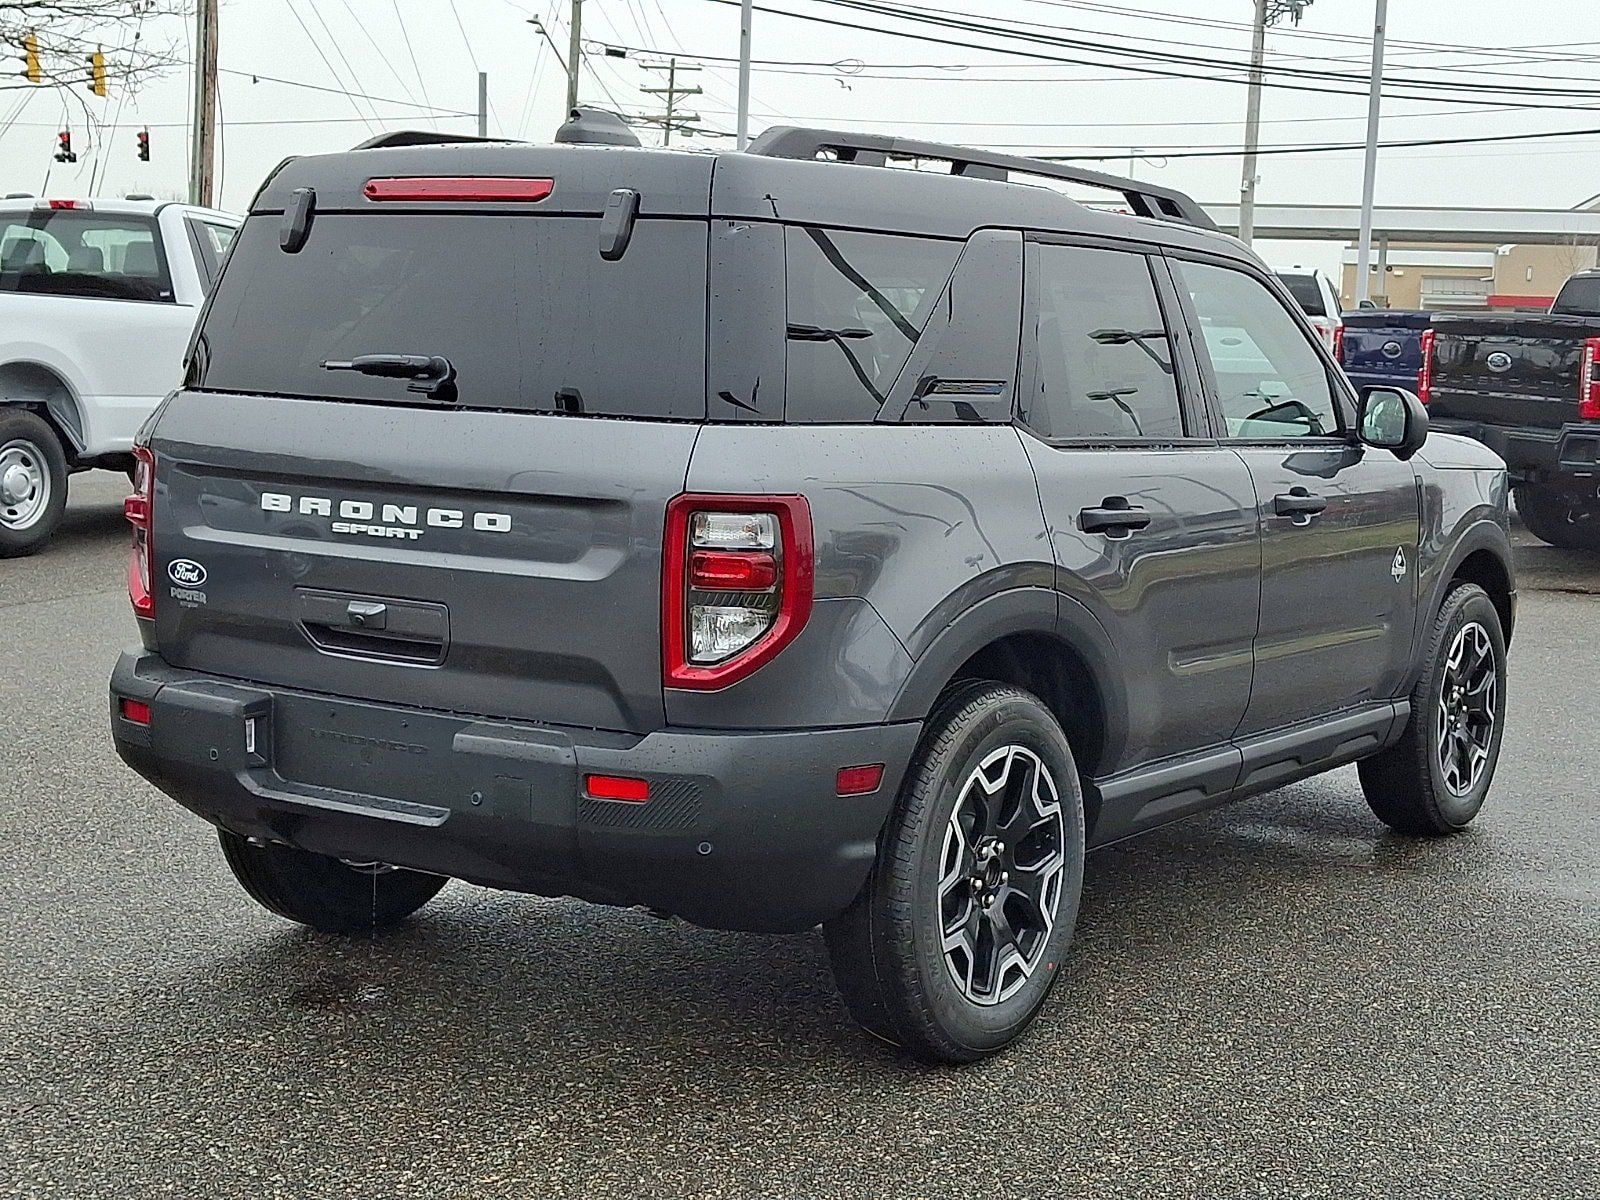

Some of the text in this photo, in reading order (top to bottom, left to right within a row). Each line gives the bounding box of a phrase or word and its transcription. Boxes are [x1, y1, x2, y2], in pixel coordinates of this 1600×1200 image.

[261, 492, 512, 532] BRONCO
[332, 522, 425, 540] SPORT
[174, 562, 200, 582] Ford
[170, 586, 207, 604] PORTER
